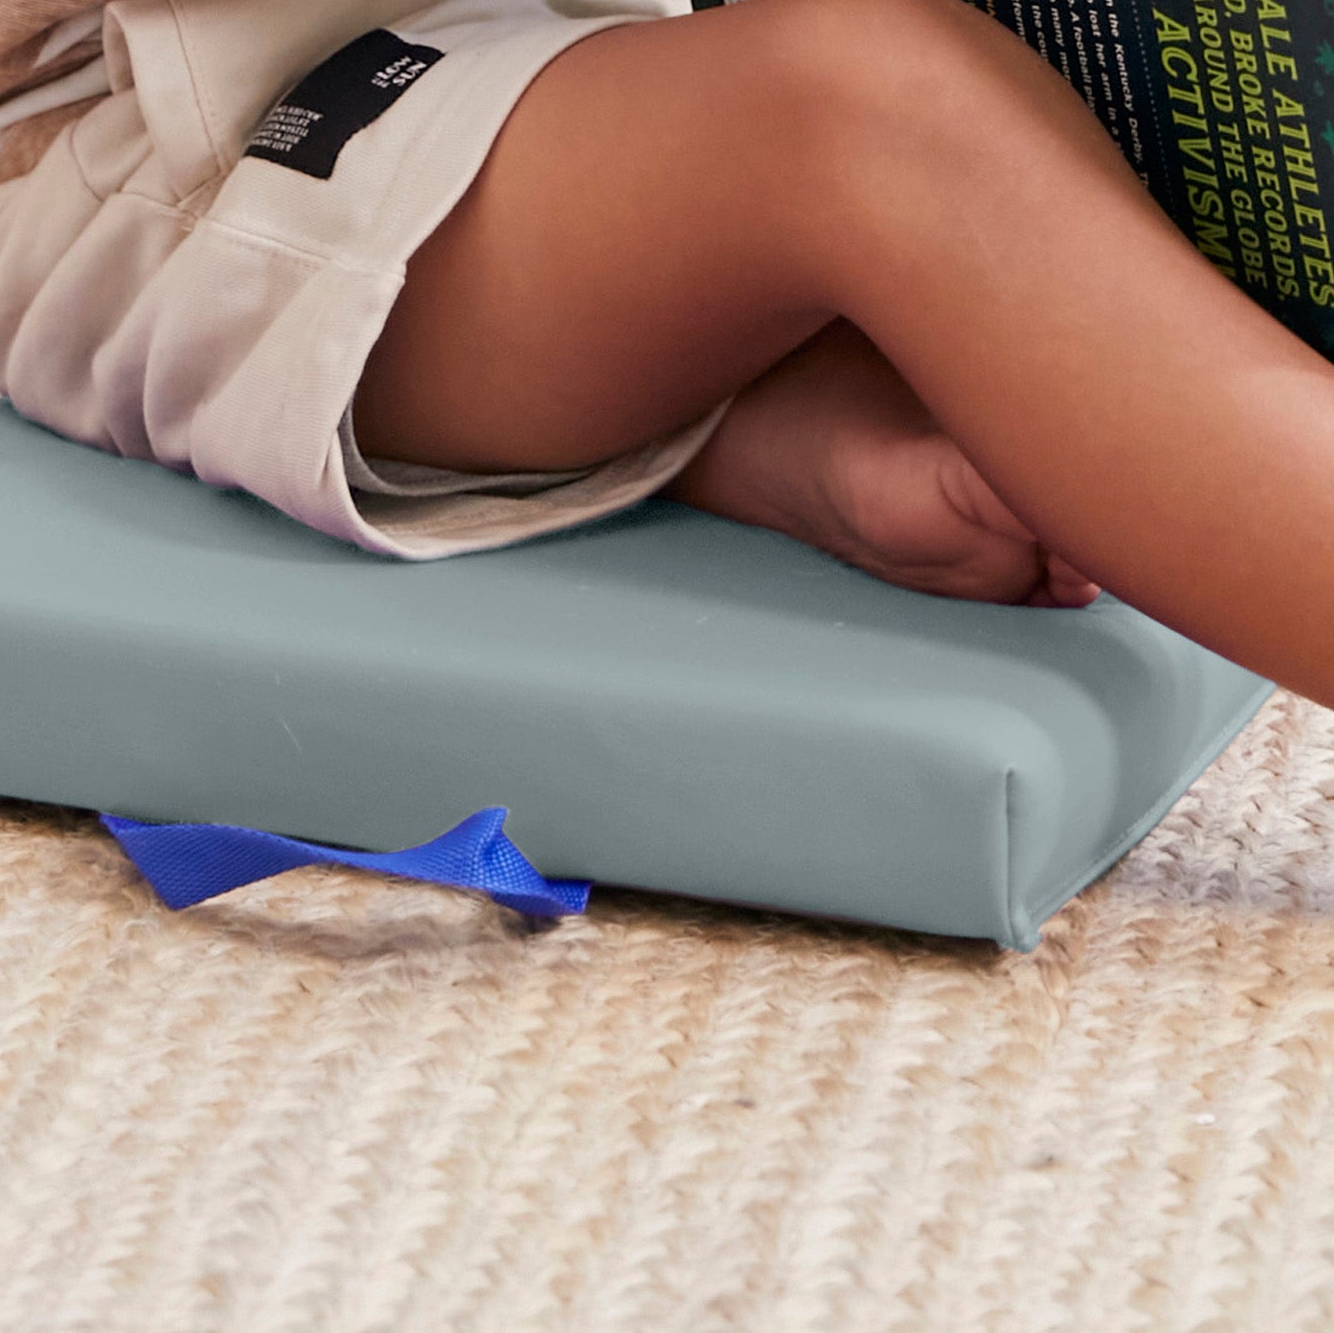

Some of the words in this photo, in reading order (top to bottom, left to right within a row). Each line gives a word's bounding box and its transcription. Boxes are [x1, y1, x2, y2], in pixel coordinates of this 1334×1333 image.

[1030, 4, 1044, 28] the
[1049, 7, 1064, 46] many
[1069, 11, 1080, 23] A
[1087, 9, 1101, 37] lost
[1107, 12, 1121, 37] the
[376, 55, 413, 80] LOW
[1072, 26, 1092, 84] football
[1094, 42, 1107, 67] her
[392, 61, 428, 88] SUN
[1100, 71, 1113, 101] arm
[1113, 43, 1134, 111] Kentucky
[1228, 28, 1271, 139] BROKE
[1107, 106, 1117, 121] in
[1111, 126, 1119, 136] a
[1216, 119, 1248, 183] THE
[1228, 187, 1268, 289] GLOBE
